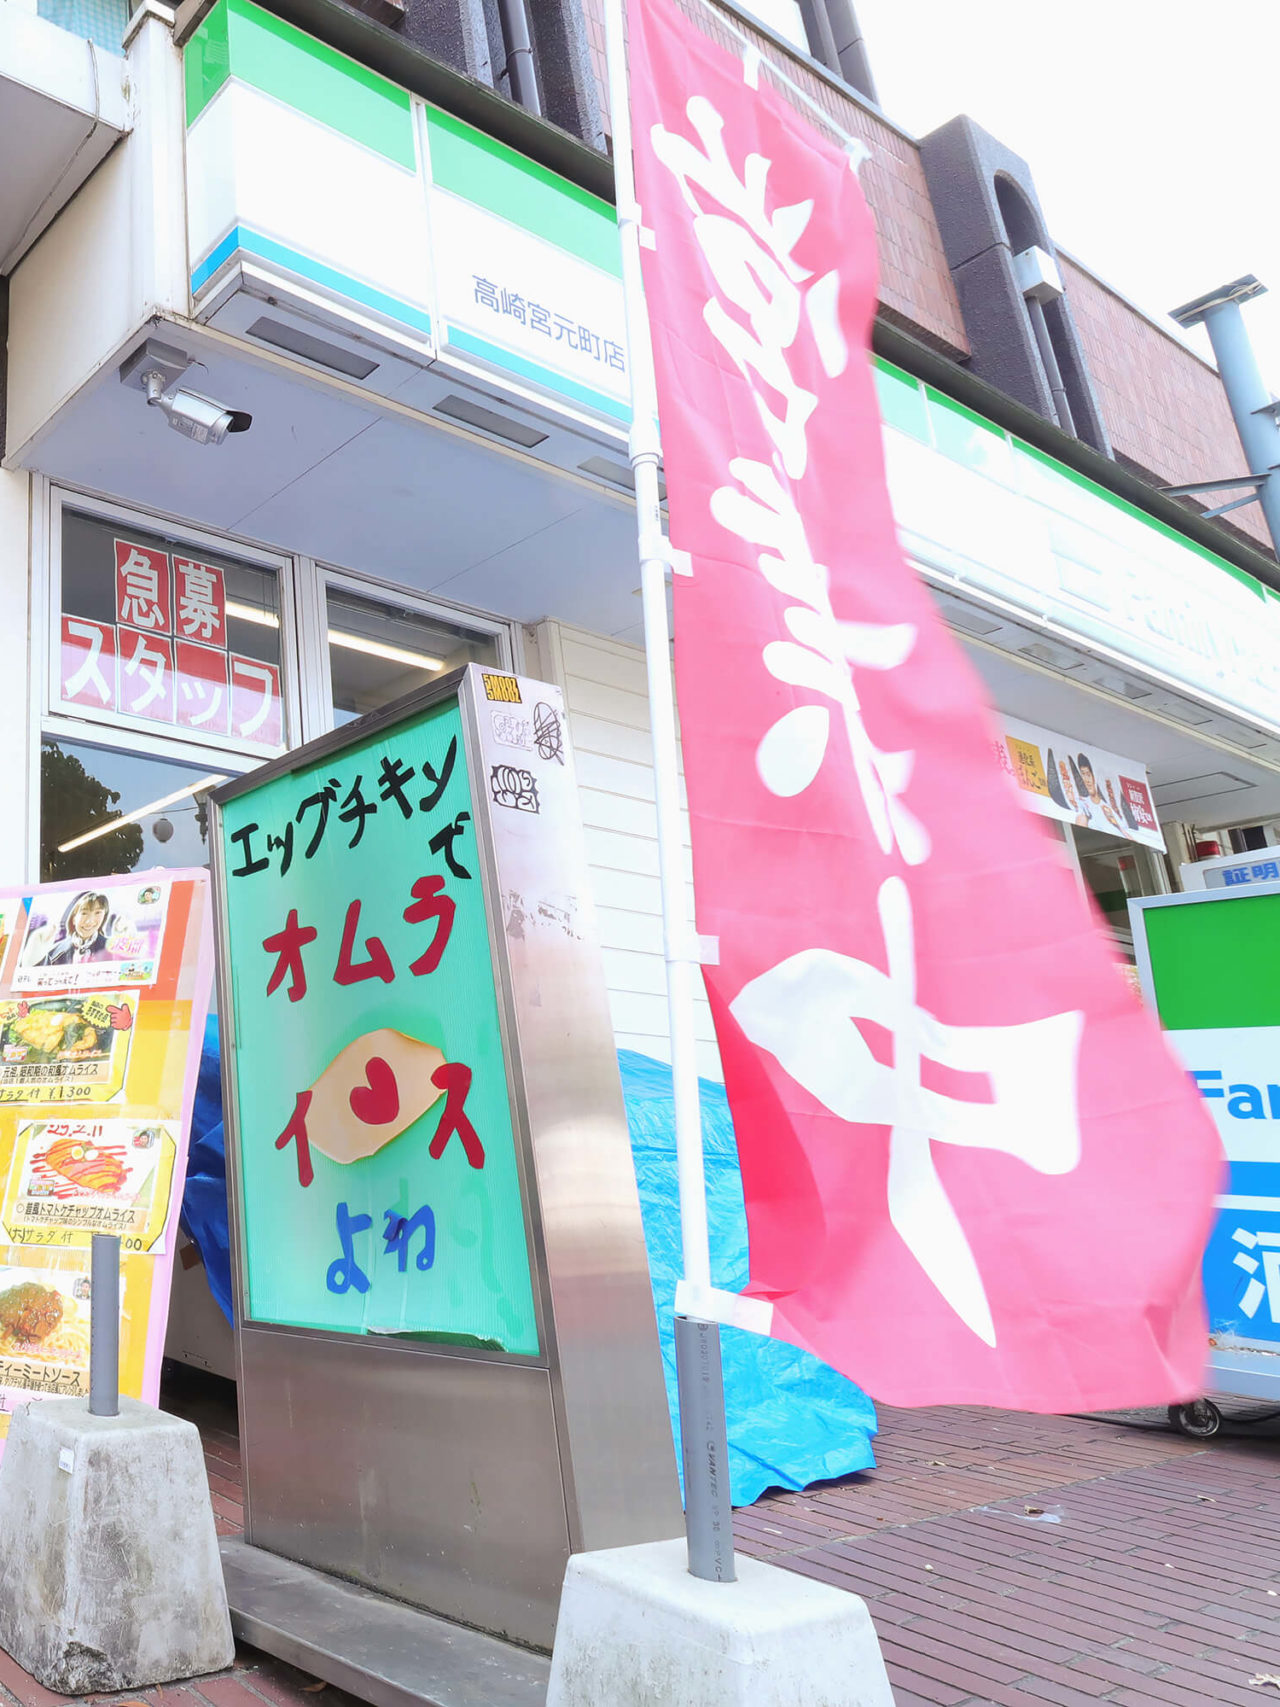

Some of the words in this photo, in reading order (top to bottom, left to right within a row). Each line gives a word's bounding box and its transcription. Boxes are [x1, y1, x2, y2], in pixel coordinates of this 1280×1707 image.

[472, 274, 625, 373] 高崎宮元町店
[120, 548, 220, 640] 急募
[64, 620, 273, 737] スタッフ
[650, 96, 1085, 1348] 営業中
[232, 735, 458, 877] エッグチキン
[428, 811, 471, 880] で
[1222, 861, 1280, 887] 証明
[263, 874, 456, 1002] オムラ
[274, 1062, 485, 1188] イス
[326, 1200, 436, 1295] よね
